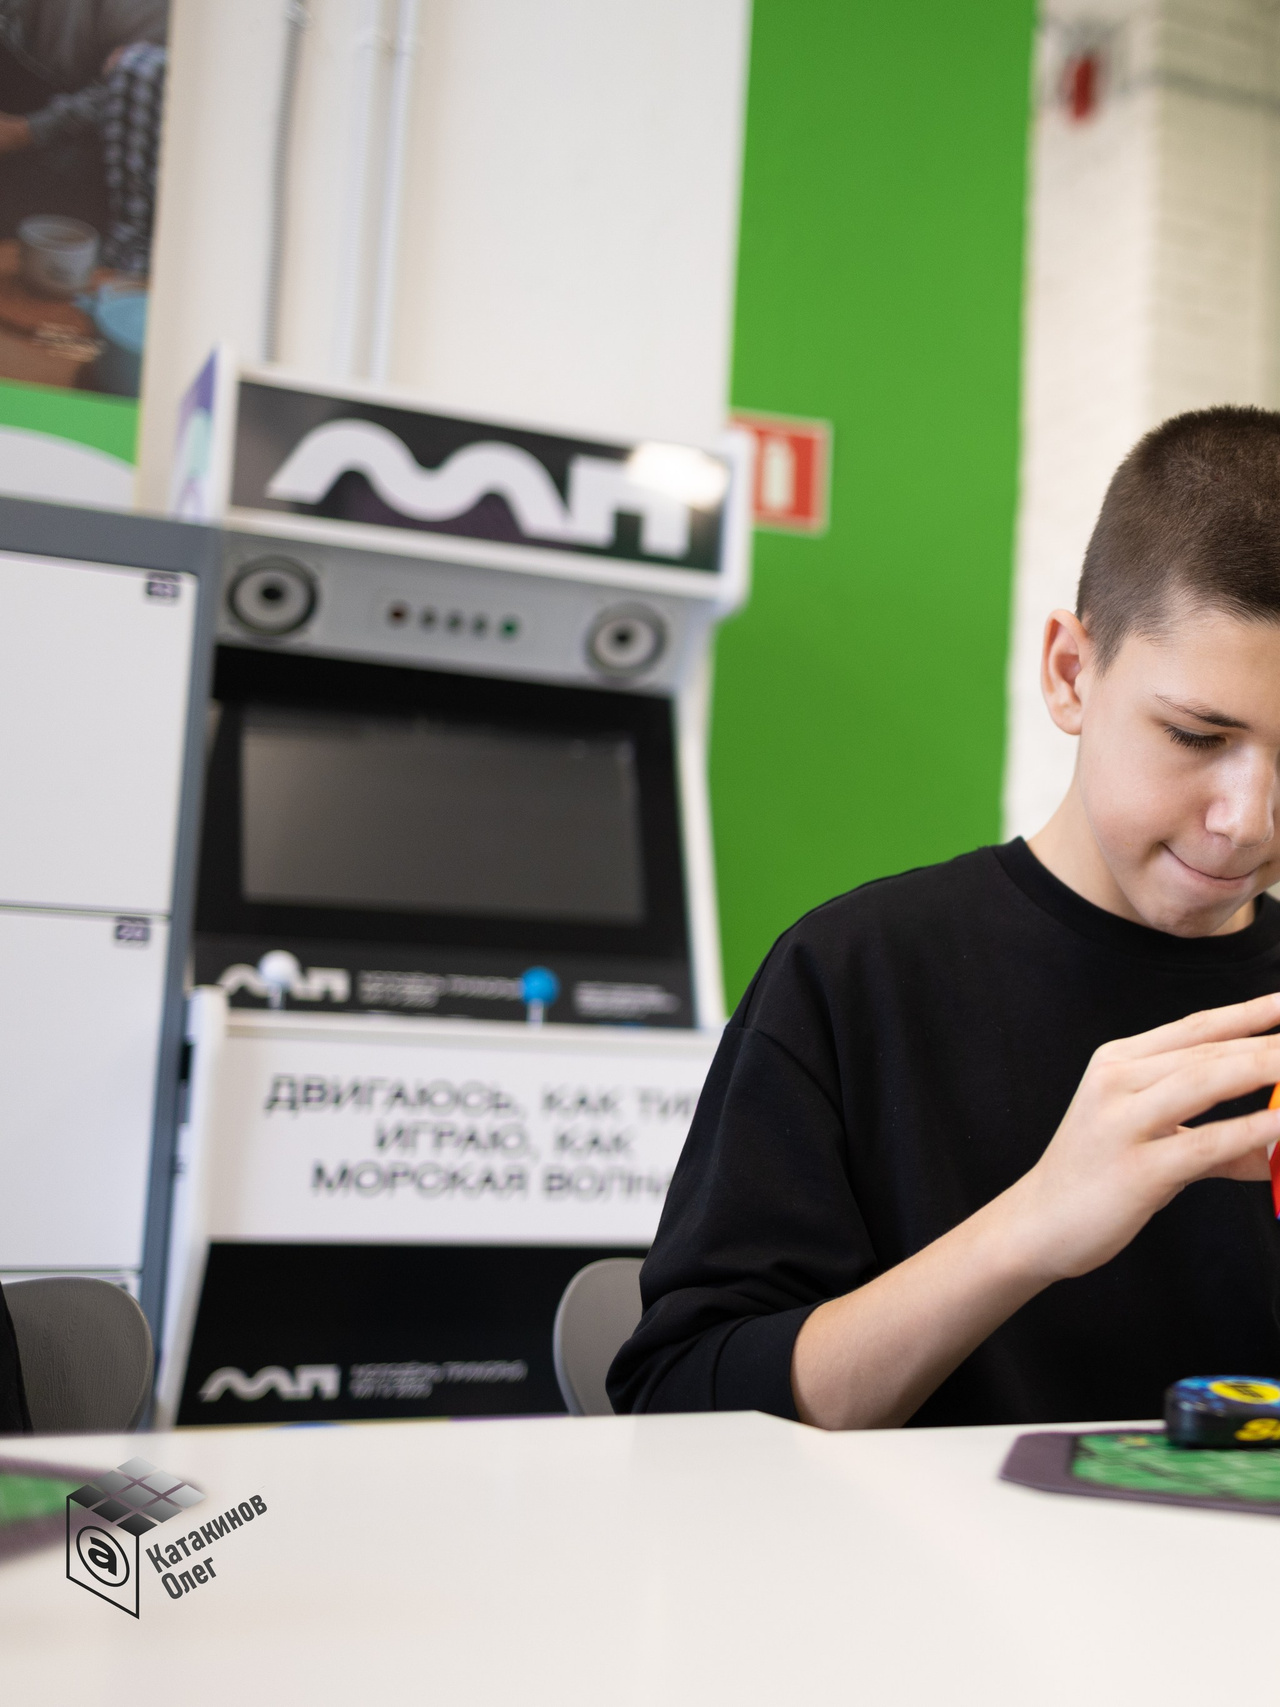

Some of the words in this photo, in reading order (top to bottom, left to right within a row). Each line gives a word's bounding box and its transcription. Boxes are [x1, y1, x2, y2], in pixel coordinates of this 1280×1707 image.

[542, 1083, 621, 1119] КАК
[554, 1126, 637, 1158] КАК
[311, 1158, 528, 1199] МОРСКАЯ
[543, 1166, 674, 1200] ВОЛН
